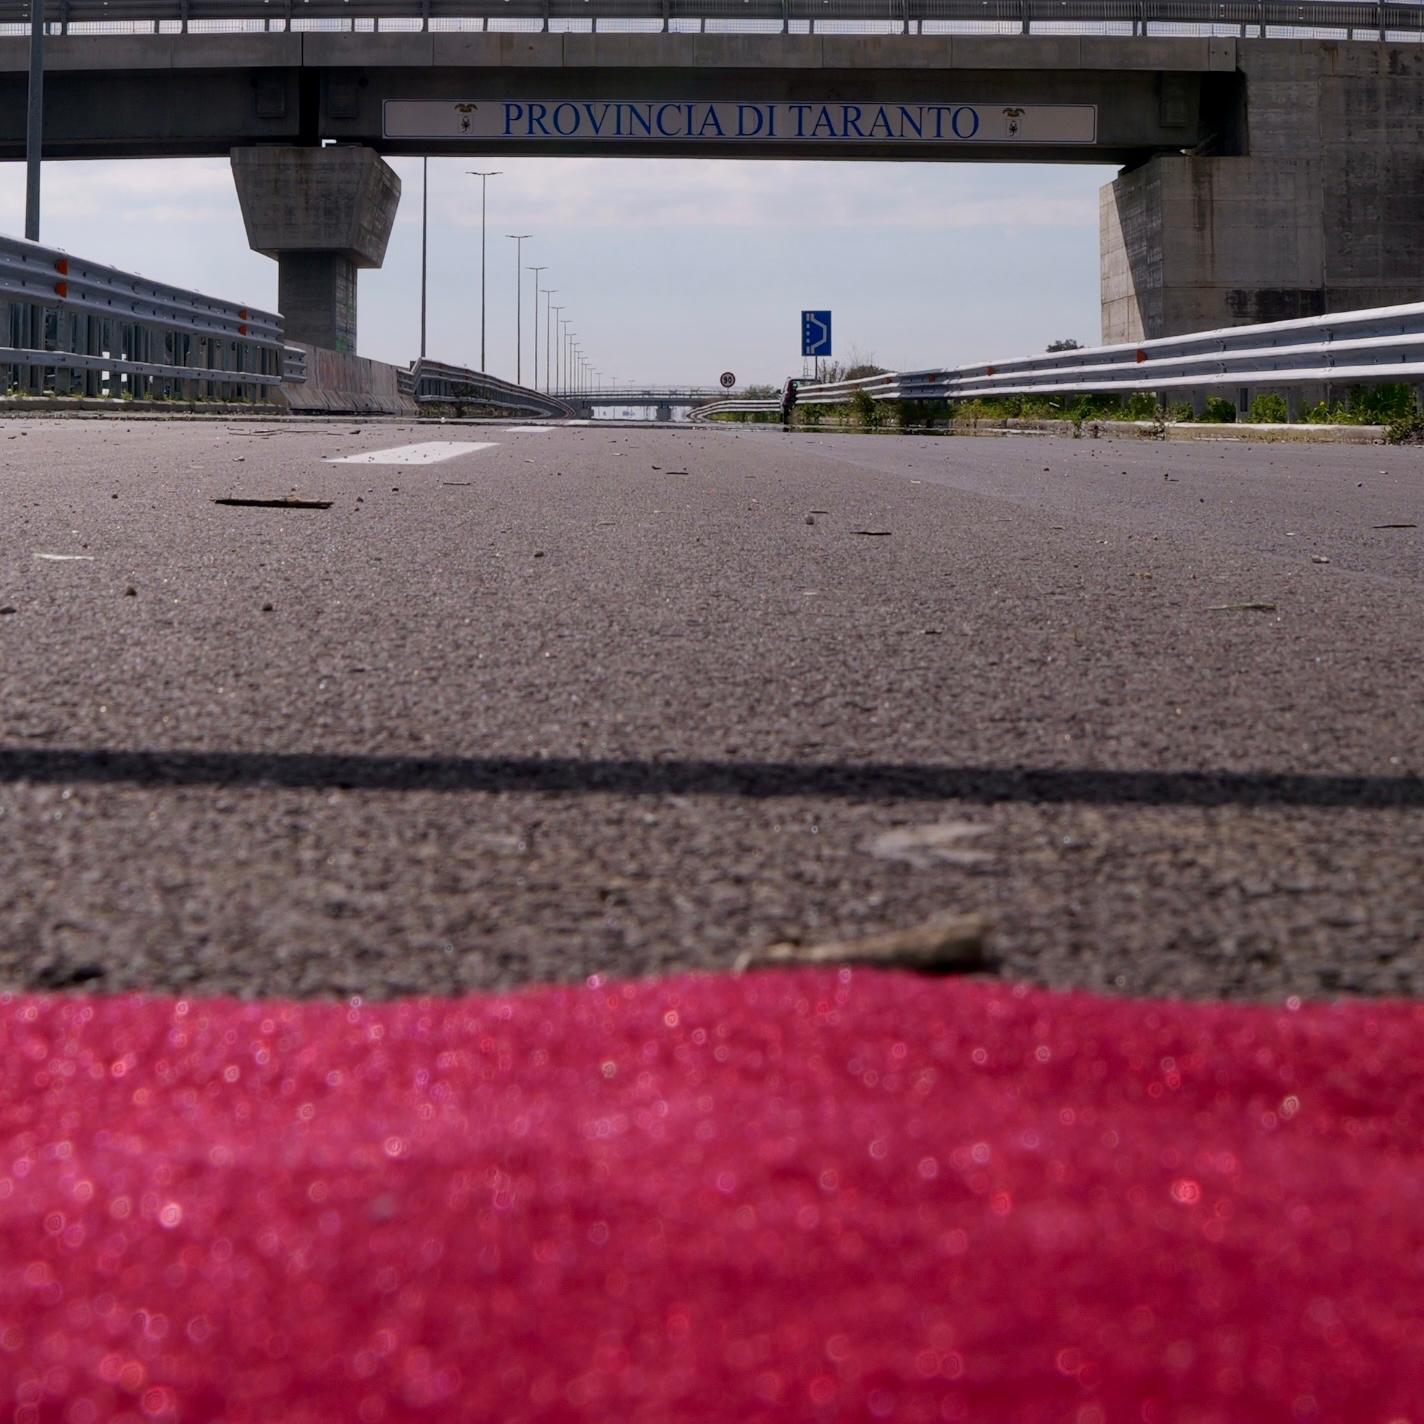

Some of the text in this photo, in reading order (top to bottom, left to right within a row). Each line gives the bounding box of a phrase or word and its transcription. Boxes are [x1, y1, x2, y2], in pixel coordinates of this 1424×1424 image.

[502, 103, 979, 139] PROVINCIA DI TARANTO
